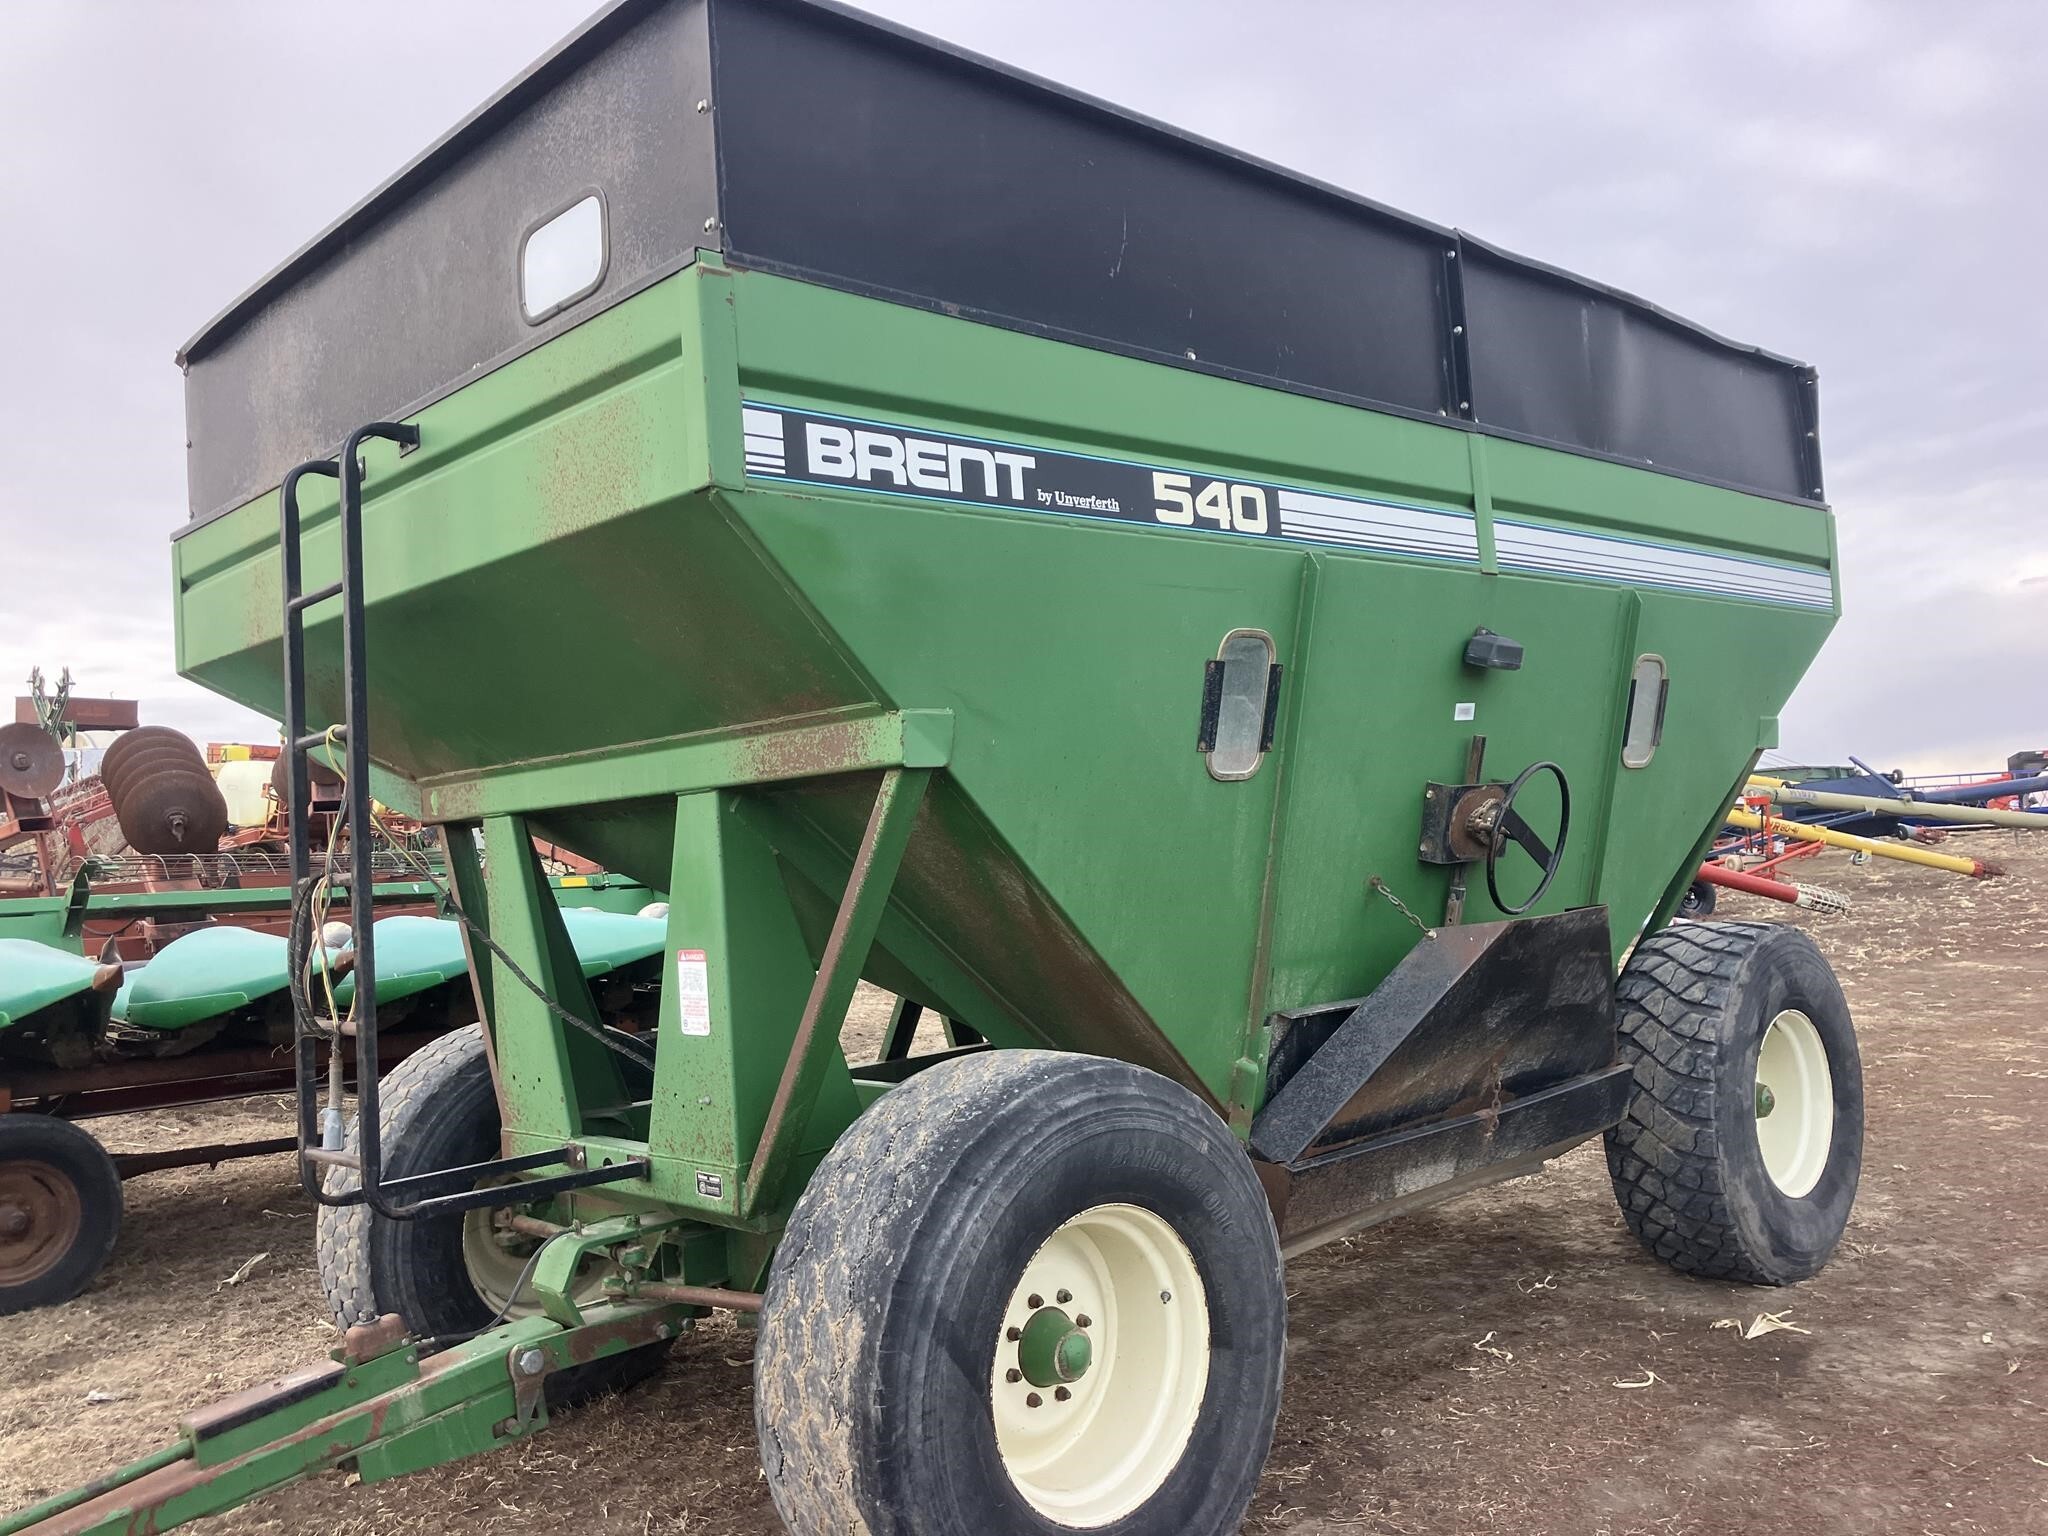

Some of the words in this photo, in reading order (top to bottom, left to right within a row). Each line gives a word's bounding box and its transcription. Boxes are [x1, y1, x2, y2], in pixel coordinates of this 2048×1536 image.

[805, 422, 1035, 500] BRENT
[1036, 488, 1053, 506] by
[1055, 491, 1120, 512] Unverferth
[1152, 471, 1268, 534] 540
